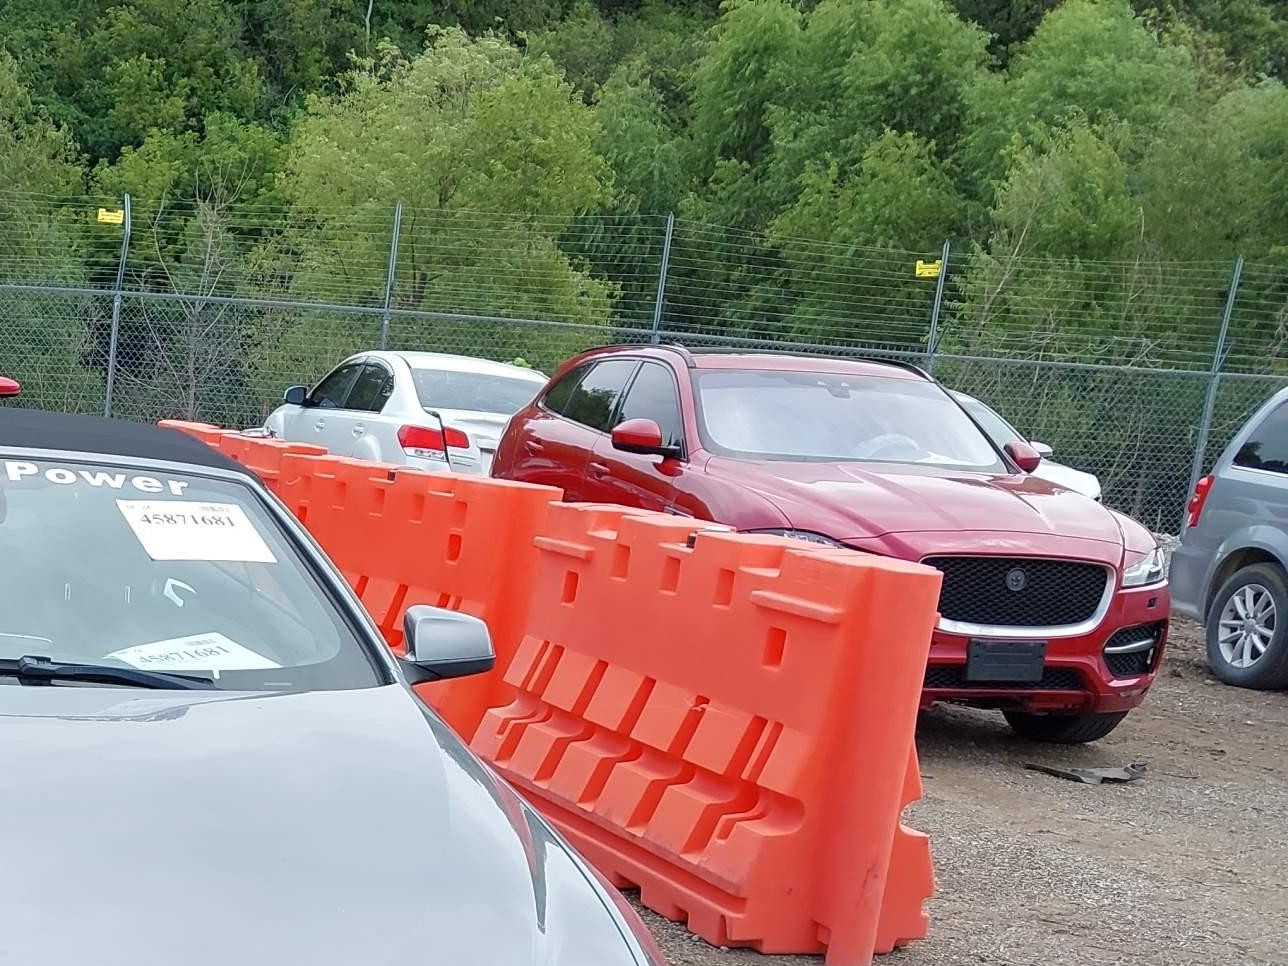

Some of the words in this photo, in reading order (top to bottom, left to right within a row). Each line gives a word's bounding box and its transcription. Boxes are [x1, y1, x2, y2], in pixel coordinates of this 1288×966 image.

[5, 461, 188, 495] Power
[140, 513, 235, 527] 45871681
[139, 645, 232, 664] 45871681
